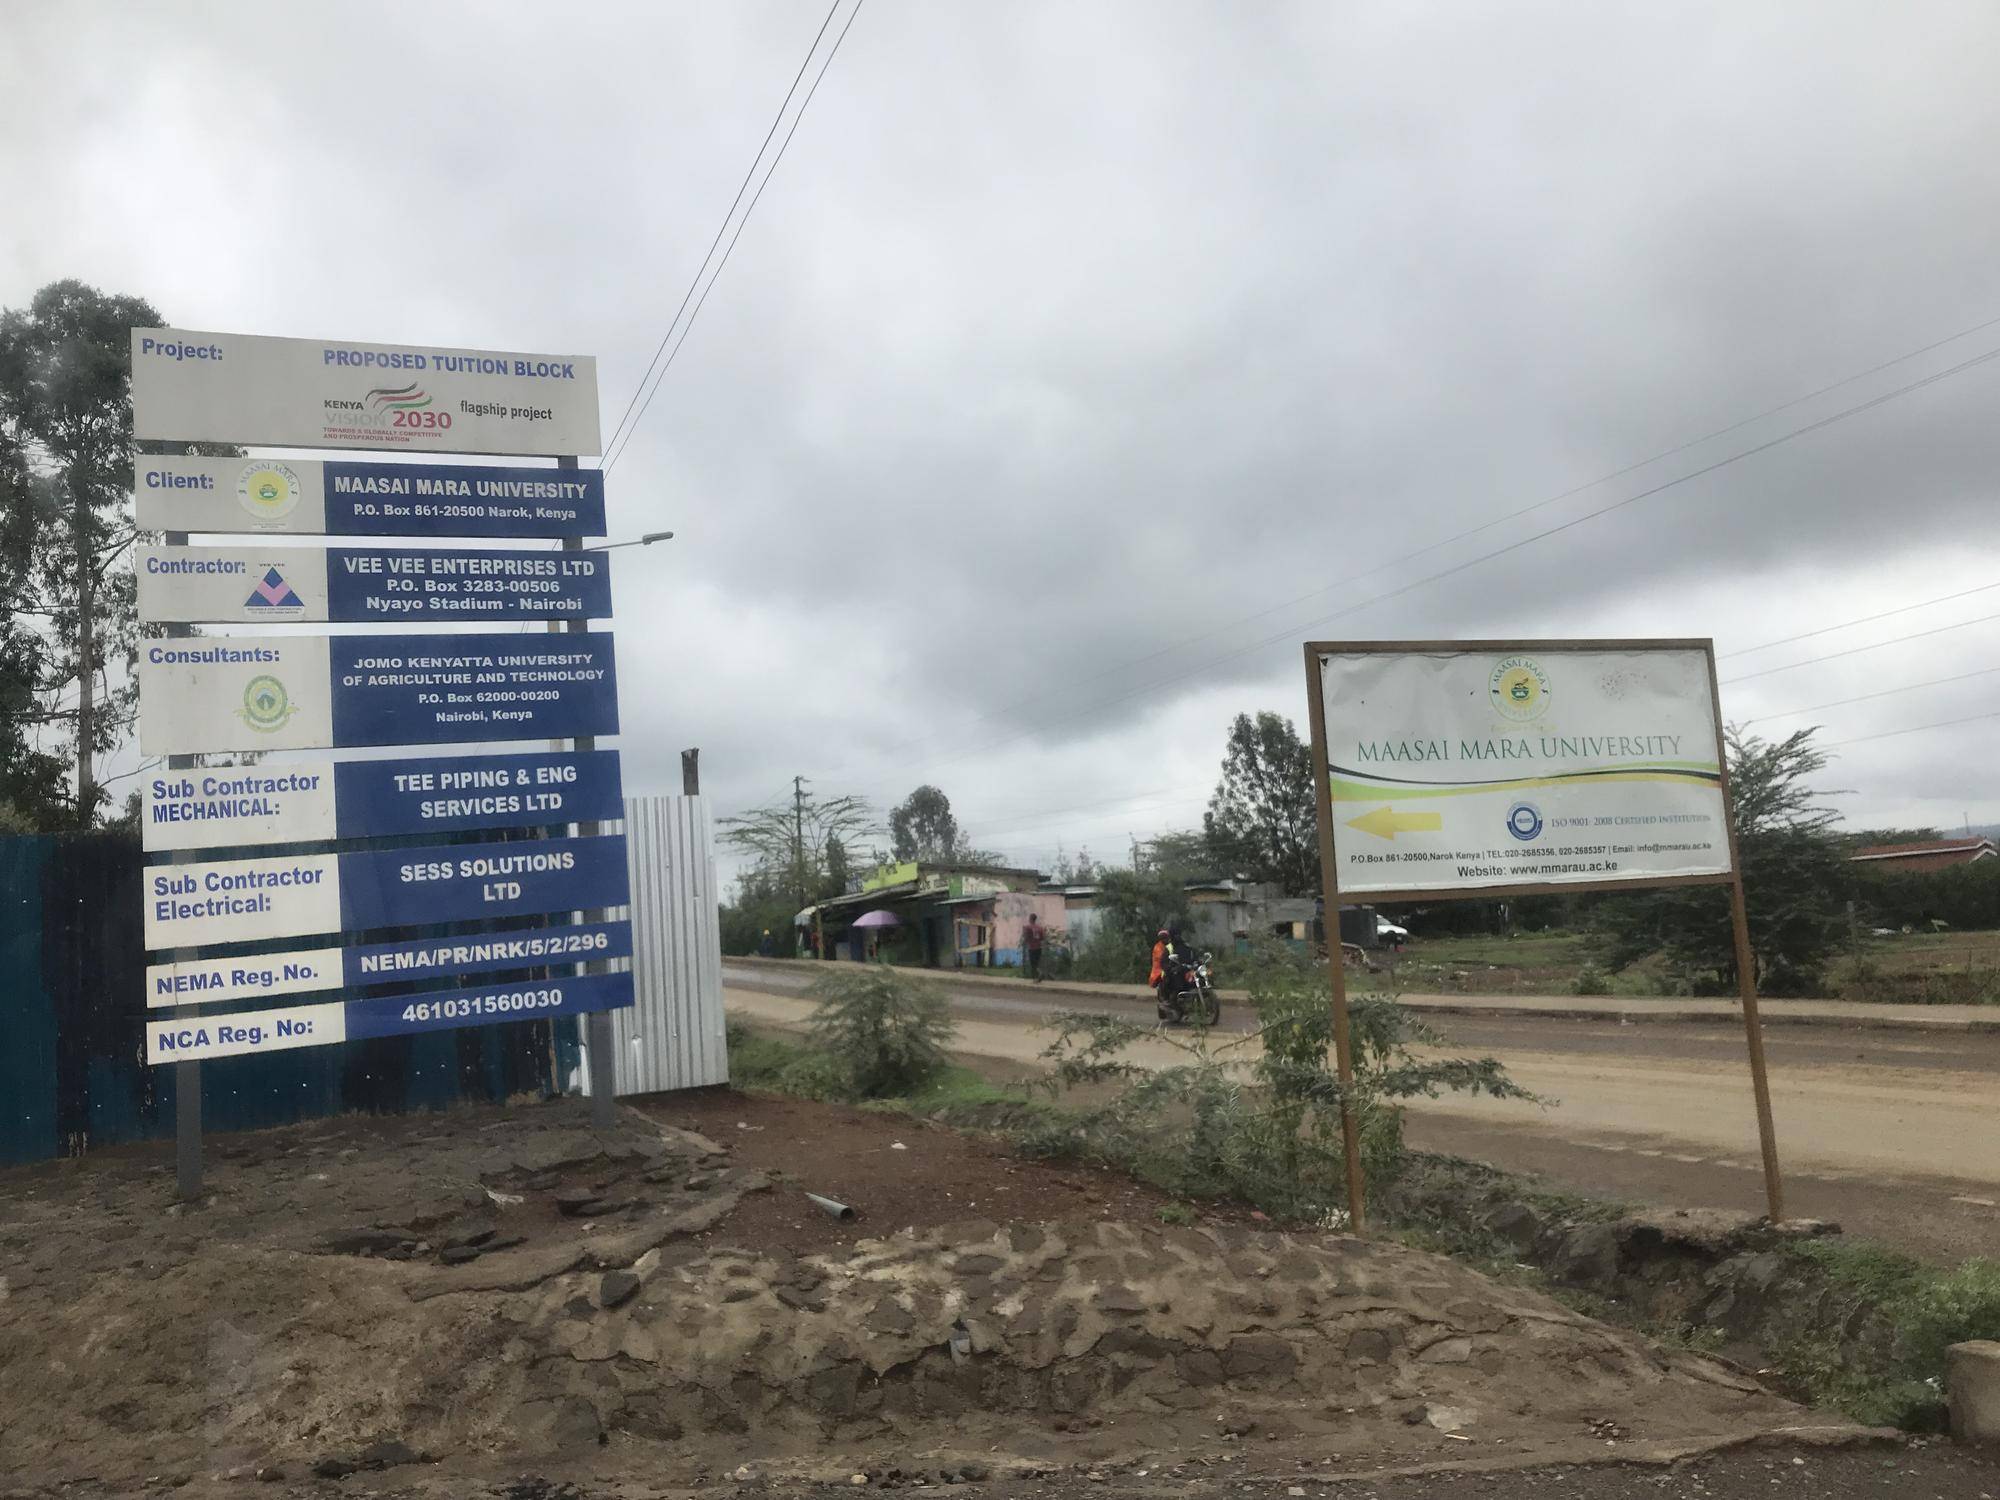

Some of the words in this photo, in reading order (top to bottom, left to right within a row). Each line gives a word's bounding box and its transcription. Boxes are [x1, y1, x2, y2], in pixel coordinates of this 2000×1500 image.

[142, 338, 223, 361] Project:
[324, 350, 426, 370] PROPOSED
[431, 355, 508, 375] TUITION
[515, 361, 575, 379] BLOCK
[324, 400, 364, 410] KENYA
[460, 400, 506, 418] flagship
[511, 406, 552, 421] project
[326, 413, 385, 425] VISION
[393, 411, 452, 429] 2030
[146, 471, 214, 489] Client:
[334, 477, 409, 494] MAASAI
[417, 479, 471, 496] MARA
[477, 481, 587, 499] UNIVERSITY
[354, 504, 379, 515] P.O.
[384, 505, 410, 516] Box
[415, 505, 484, 517] 861-20500
[489, 507, 533, 519] Narok,
[536, 508, 576, 521] Kenya
[147, 557, 246, 574] Contractor:
[344, 557, 382, 573] VEE
[388, 558, 425, 574] VEE
[431, 559, 556, 575] ENTERPRISES
[562, 561, 595, 576] LTD
[387, 579, 419, 591] P.O.
[425, 580, 457, 592] Box
[463, 581, 560, 592] 3283-00506
[366, 597, 423, 612] Nyayo
[429, 598, 503, 610] Stadium
[519, 598, 582, 610] Nairobi
[150, 648, 279, 663] Consultants:
[354, 659, 402, 669] JOMO
[408, 657, 493, 668] KENYATTA
[498, 654, 593, 666] UNIVERSITY
[343, 676, 362, 686] OF
[368, 674, 472, 686] AGRICULTURE
[476, 673, 506, 683] AND
[510, 669, 605, 682] TECHNOLOGY
[1493, 659, 1521, 682] MAASAI
[1524, 661, 1546, 684] MARA
[419, 693, 443, 704] P.O.
[447, 693, 473, 703] Box
[476, 691, 560, 702] 62000-00200
[436, 711, 488, 722] Nairobi,
[492, 710, 533, 721] Kenya
[1358, 740, 1450, 762] MAASAI
[1459, 739, 1533, 760] MARA
[1541, 735, 1681, 758] UNIVERSITY
[153, 780, 194, 799] Sub
[202, 774, 320, 796] Contractor
[394, 774, 434, 792] TEE
[441, 770, 509, 789] PIPING
[517, 769, 530, 785] &
[537, 766, 577, 784] ENG
[153, 798, 280, 823] MECHANICAL:
[421, 796, 520, 819] SERVICES
[526, 793, 562, 811] LTD
[1552, 818, 1567, 827] ISO
[1594, 817, 1613, 826] 2008
[1351, 855, 1383, 863] P.O.Box
[1456, 852, 1480, 860] Kenya
[1613, 845, 1636, 853] Email:
[400, 862, 453, 883] SESS
[460, 852, 575, 878] SOLUTIONS
[1458, 866, 1507, 877] Website:
[1510, 860, 1618, 875] www.mmarau.ac.ke
[154, 875, 197, 896] Sub
[205, 867, 323, 891] Contractor
[483, 883, 521, 901] LTD
[156, 893, 270, 921] Electrical:
[360, 933, 608, 973] NEMA/PR/NRK/5/2/296
[157, 972, 224, 995] NEMA
[231, 970, 279, 987] Reg.
[283, 964, 318, 981] No.
[402, 989, 562, 1022] 461031560030
[159, 1029, 210, 1051] NCA
[218, 1026, 268, 1044] Reg.
[277, 1019, 313, 1037] No:
